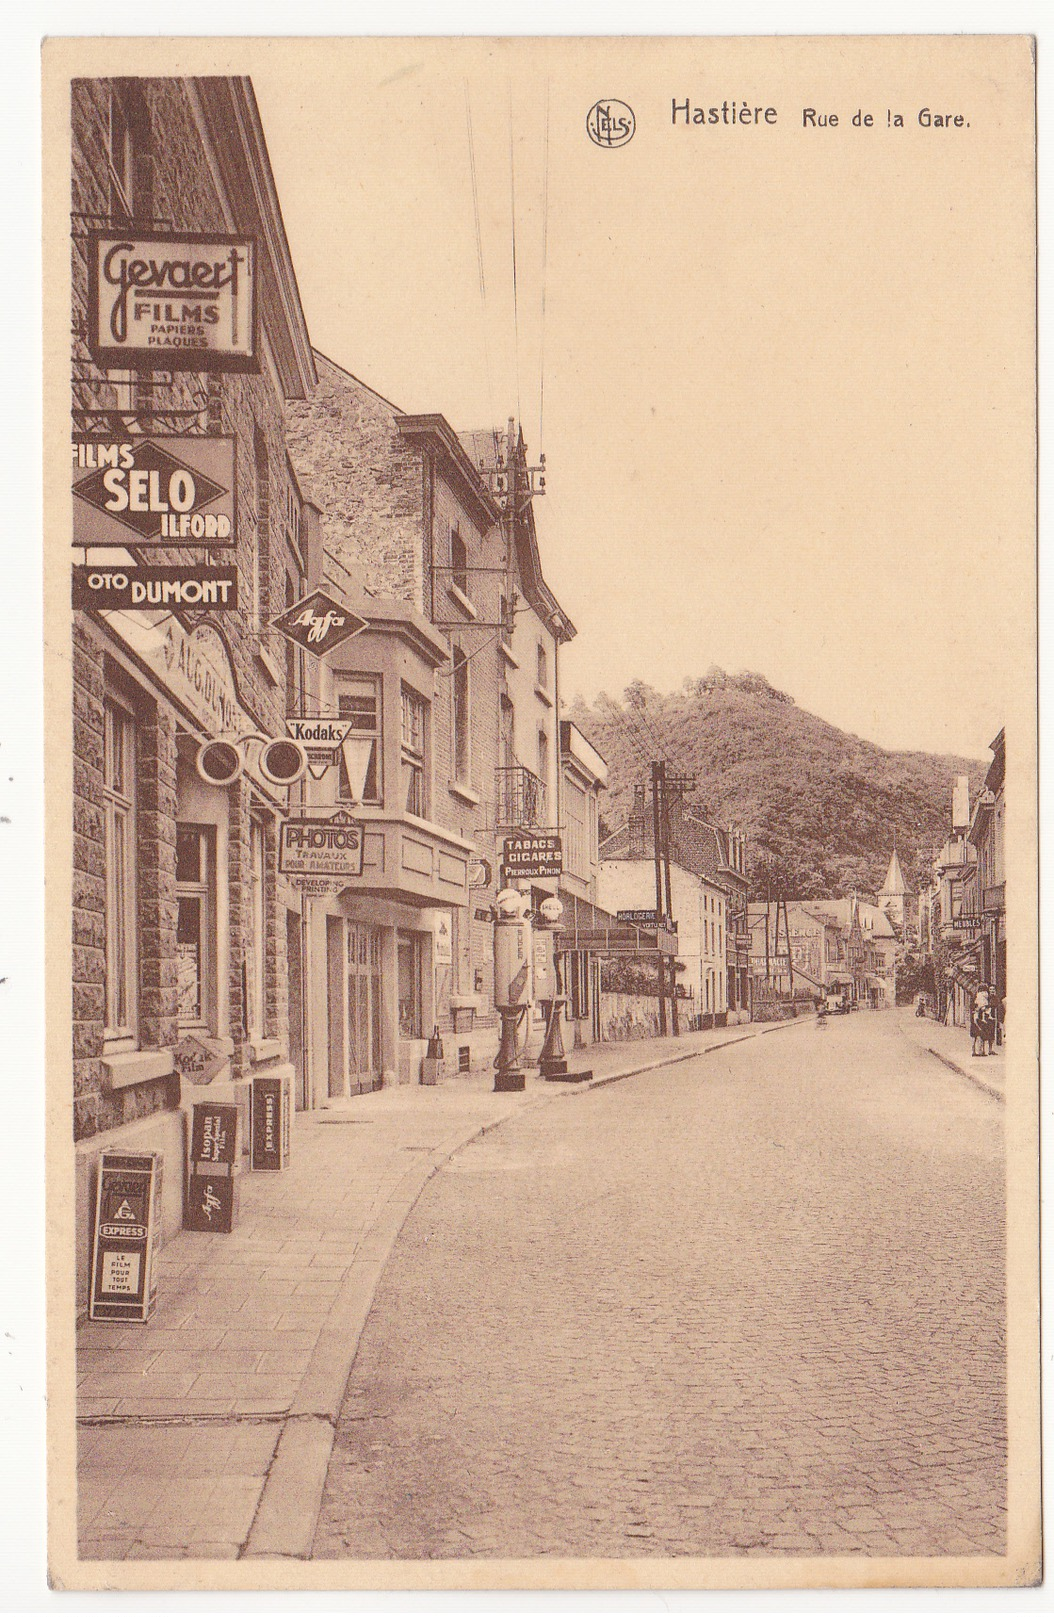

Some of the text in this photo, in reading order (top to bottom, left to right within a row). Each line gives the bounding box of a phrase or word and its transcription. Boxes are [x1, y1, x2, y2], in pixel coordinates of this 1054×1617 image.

[104, 242, 245, 345] Gevaert
[134, 303, 220, 324] FILMS
[150, 324, 206, 336] PAPIERS
[148, 336, 209, 348] PLAQUES
[103, 468, 196, 512] SELO
[161, 513, 231, 538] ILFORD
[87, 573, 232, 603] OTO DUMONT
[288, 609, 346, 643] Agfa
[286, 828, 359, 850] PHOTOS
[506, 840, 555, 850] TABACS
[295, 850, 347, 860] TRAVAUX
[509, 851, 562, 862] CIGARES
[201, 1116, 216, 1159] Isopan
[201, 1184, 221, 1221] Agfa
[103, 1226, 144, 1236] EXPRESS
